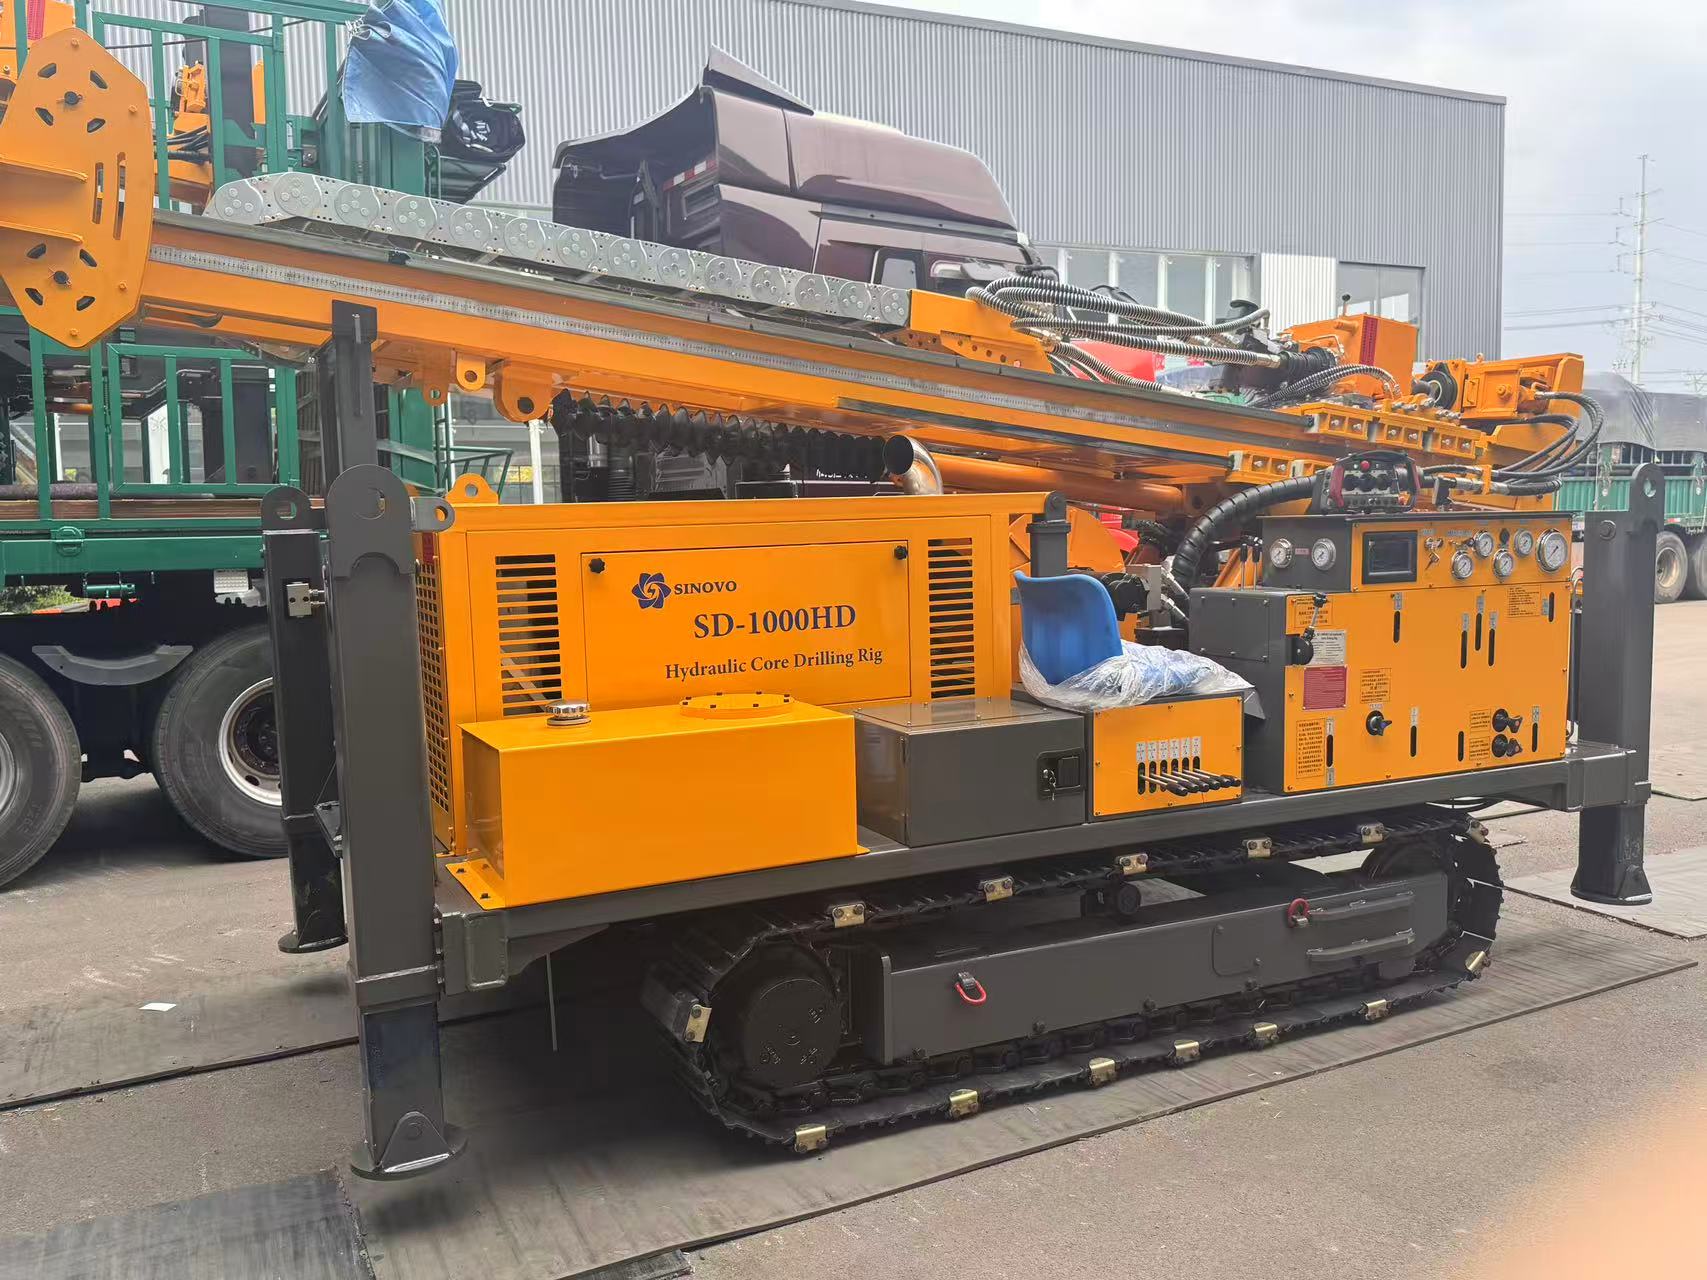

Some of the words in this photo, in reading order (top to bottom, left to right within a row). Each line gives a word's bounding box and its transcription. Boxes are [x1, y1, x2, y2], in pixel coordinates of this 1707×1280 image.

[674, 580, 737, 595] SINOVO
[694, 604, 856, 639] SD-1000HD
[665, 658, 746, 682] Hydraulic
[750, 656, 789, 672] Core
[793, 650, 854, 668] Drilling
[857, 647, 883, 665] Rig
